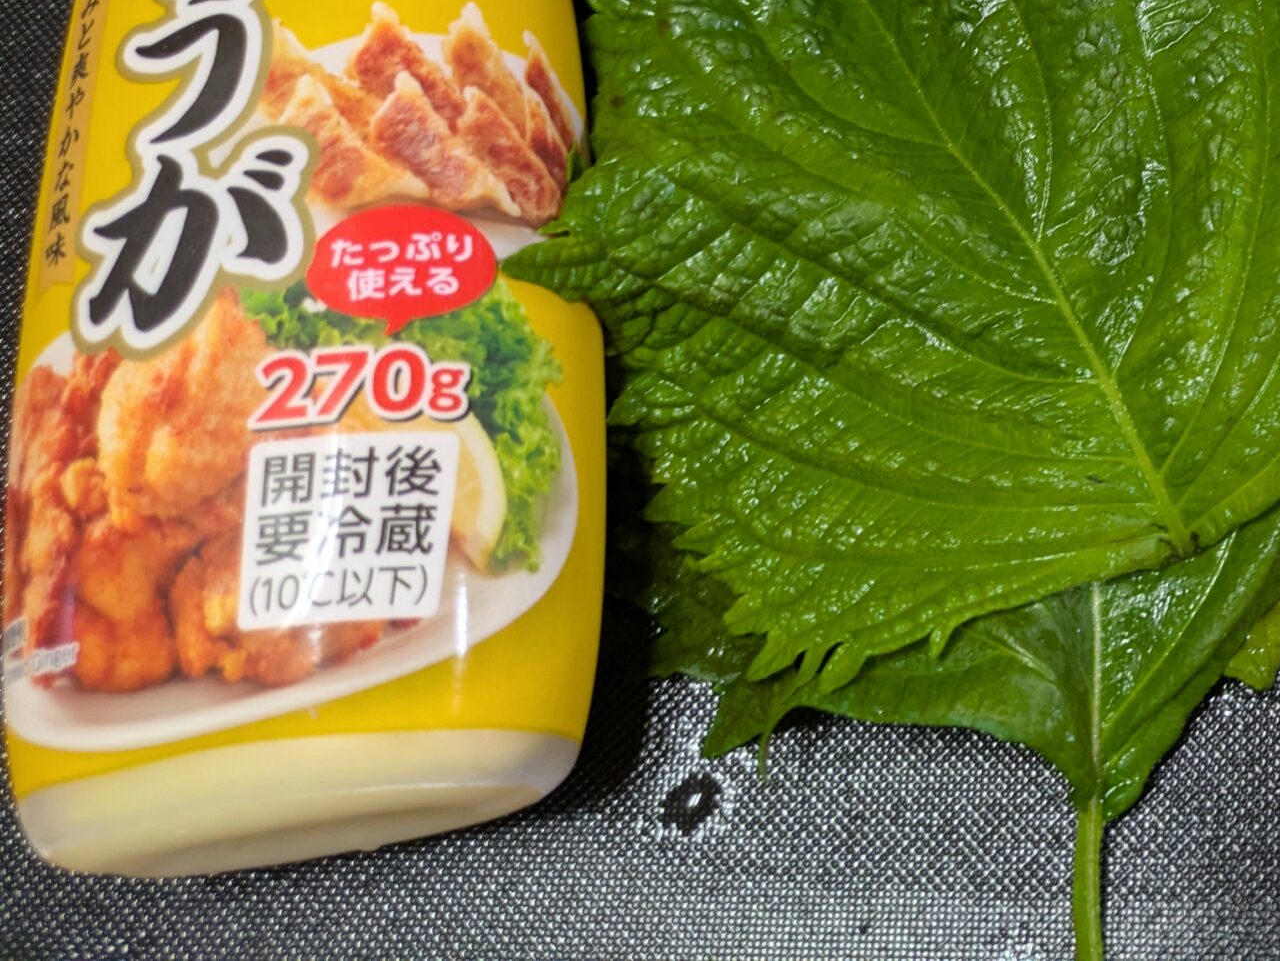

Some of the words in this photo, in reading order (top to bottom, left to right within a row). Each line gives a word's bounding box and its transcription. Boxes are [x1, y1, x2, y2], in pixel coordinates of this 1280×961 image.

[330, 231, 474, 269] たっぷり
[347, 266, 460, 302] 使える
[250, 345, 468, 426] 270g
[260, 445, 442, 507] 開封後
[255, 502, 439, 567] 要冷蔵
